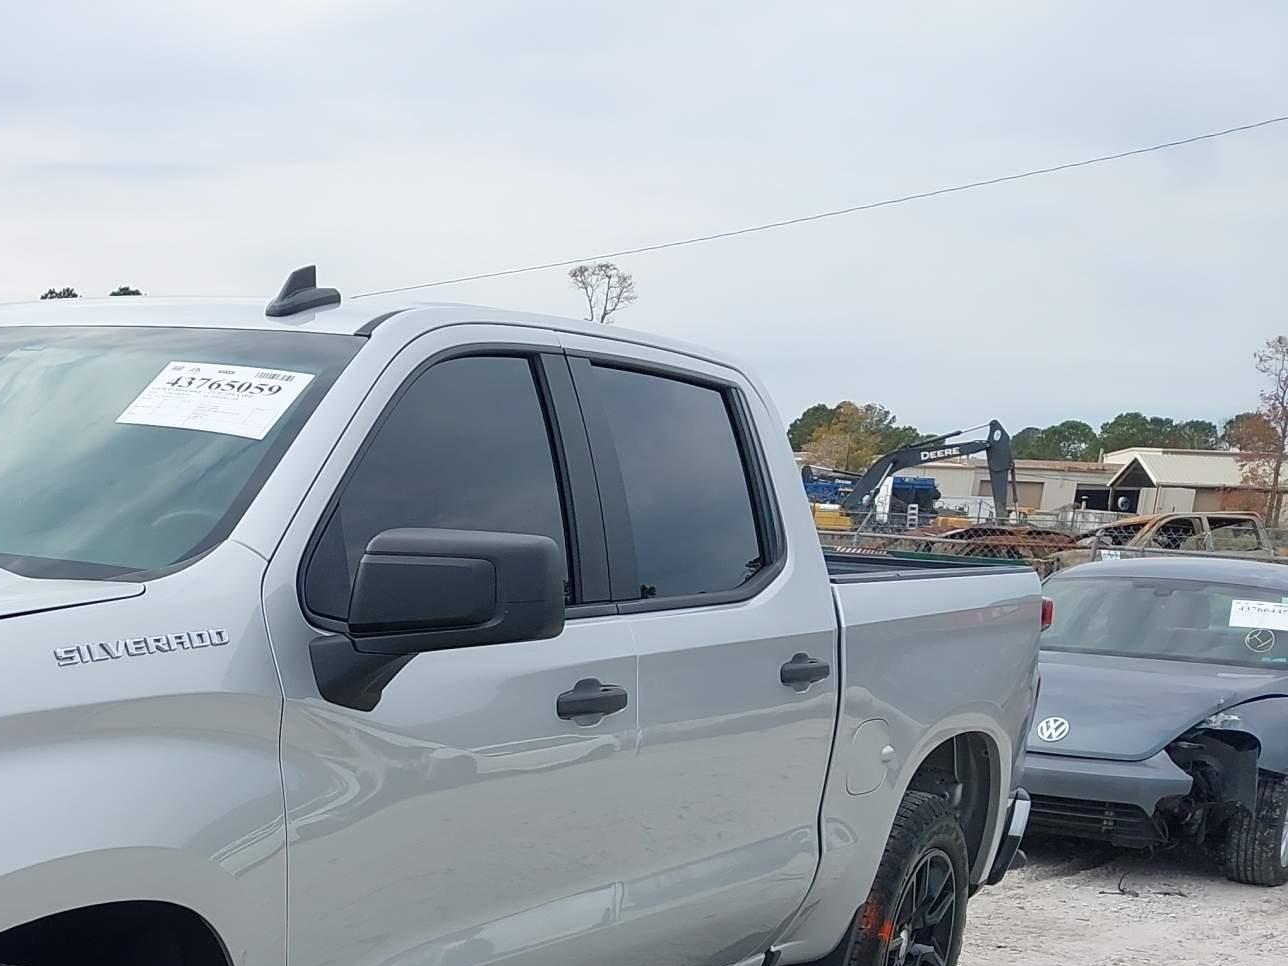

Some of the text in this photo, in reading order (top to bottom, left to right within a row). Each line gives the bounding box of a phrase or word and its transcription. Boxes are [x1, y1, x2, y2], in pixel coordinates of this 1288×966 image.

[166, 375, 283, 396] 43765059
[920, 446, 961, 461] DEERE
[54, 629, 230, 667] SILVERADO
